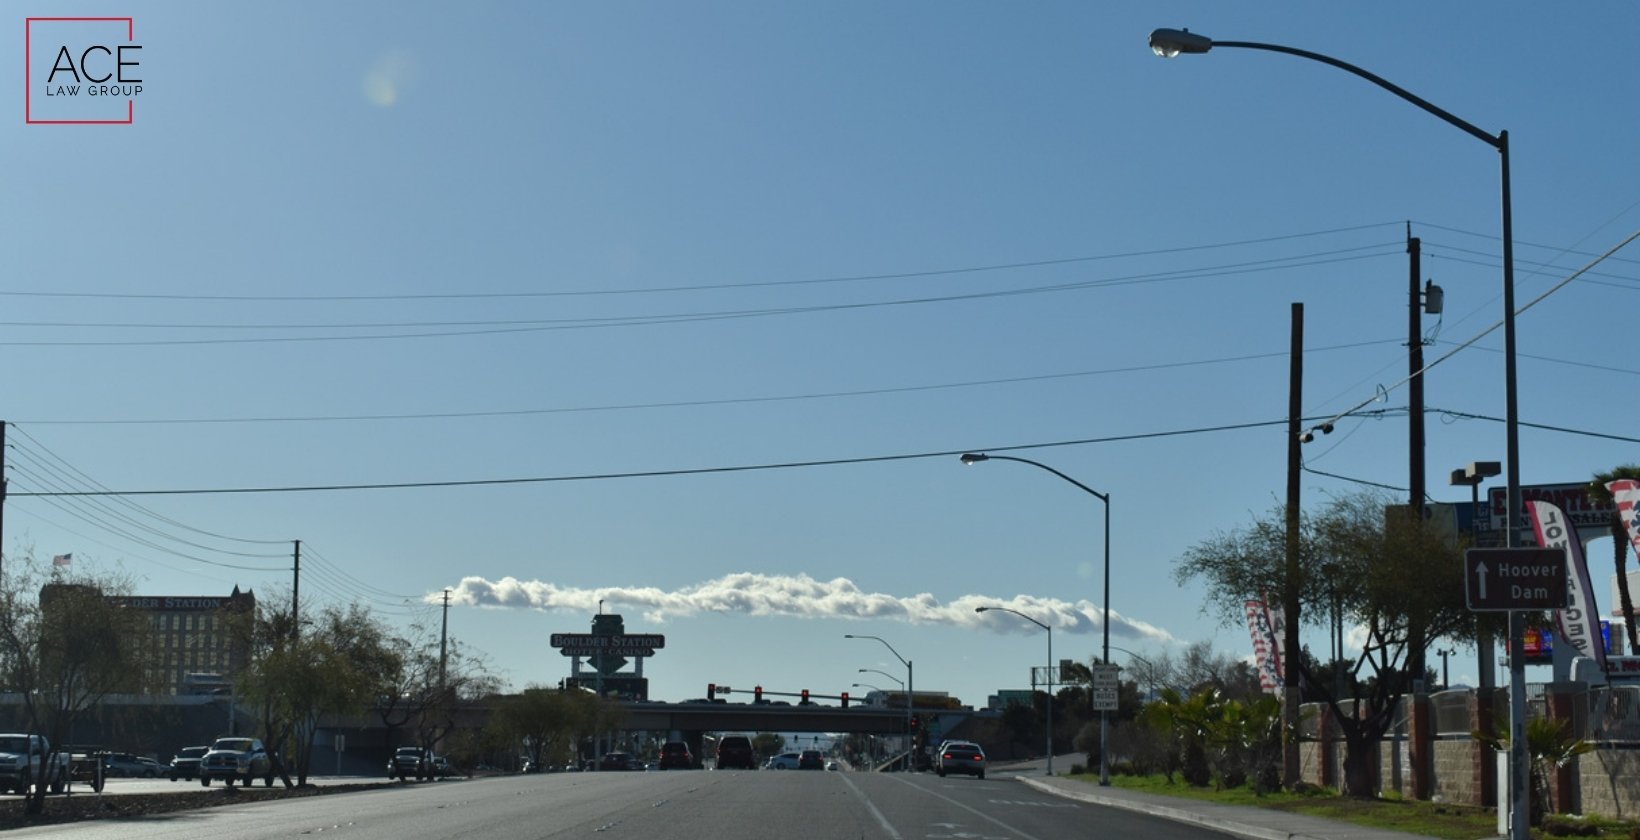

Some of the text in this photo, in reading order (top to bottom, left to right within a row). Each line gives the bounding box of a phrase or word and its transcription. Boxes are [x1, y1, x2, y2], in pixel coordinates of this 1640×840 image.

[1499, 562, 1558, 577] Hoover
[1511, 585, 1548, 600] Dam
[164, 597, 221, 608] STATION
[553, 635, 661, 647] BOULDER STATION
[608, 648, 650, 656] CASINO
